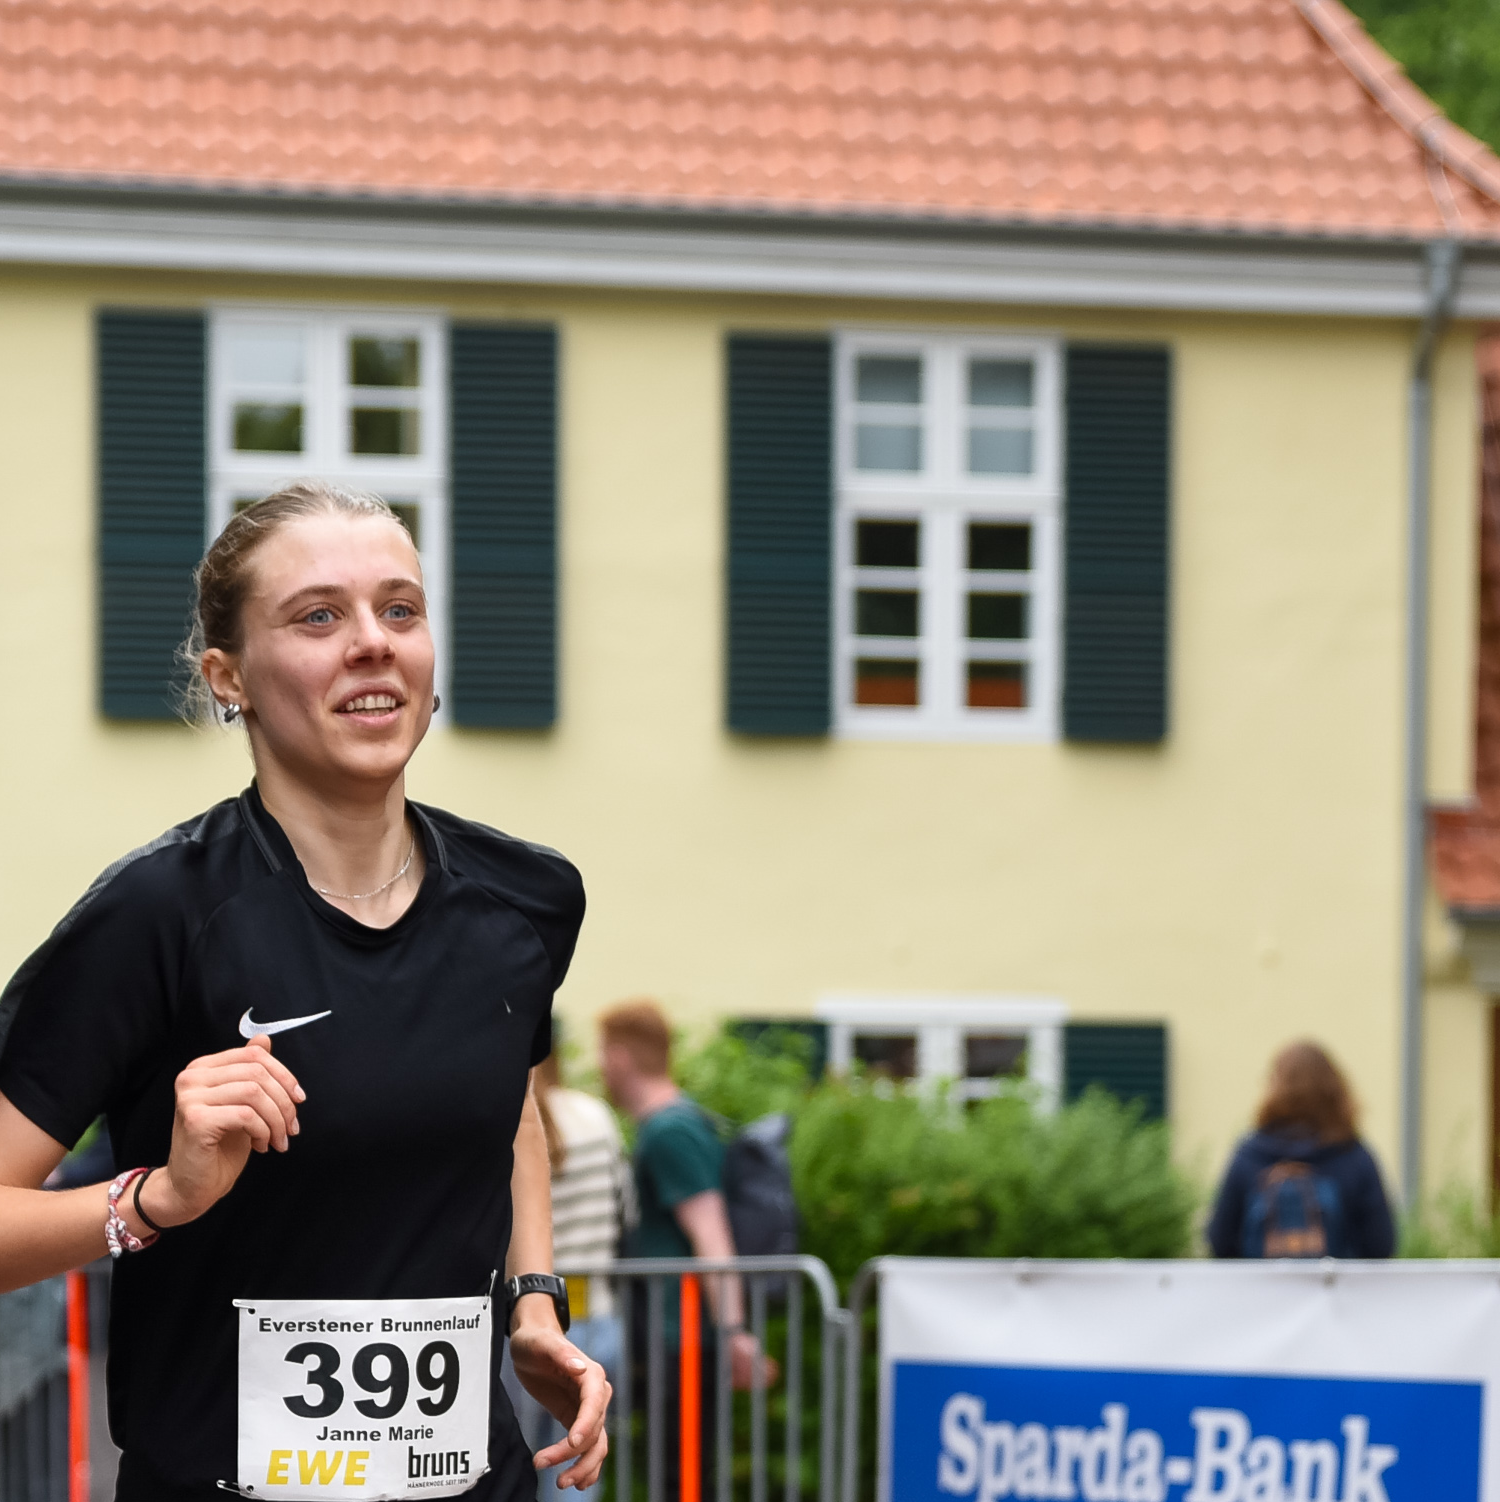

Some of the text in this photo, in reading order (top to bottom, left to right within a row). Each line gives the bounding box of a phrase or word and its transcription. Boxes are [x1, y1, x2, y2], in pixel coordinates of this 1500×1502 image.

[258, 1313, 481, 1333] Everstener Brunnenlauf
[282, 1340, 460, 1420] 399
[316, 1424, 434, 1442] Janne Marie
[266, 1449, 370, 1486] EWE
[407, 1445, 471, 1479] bruns
